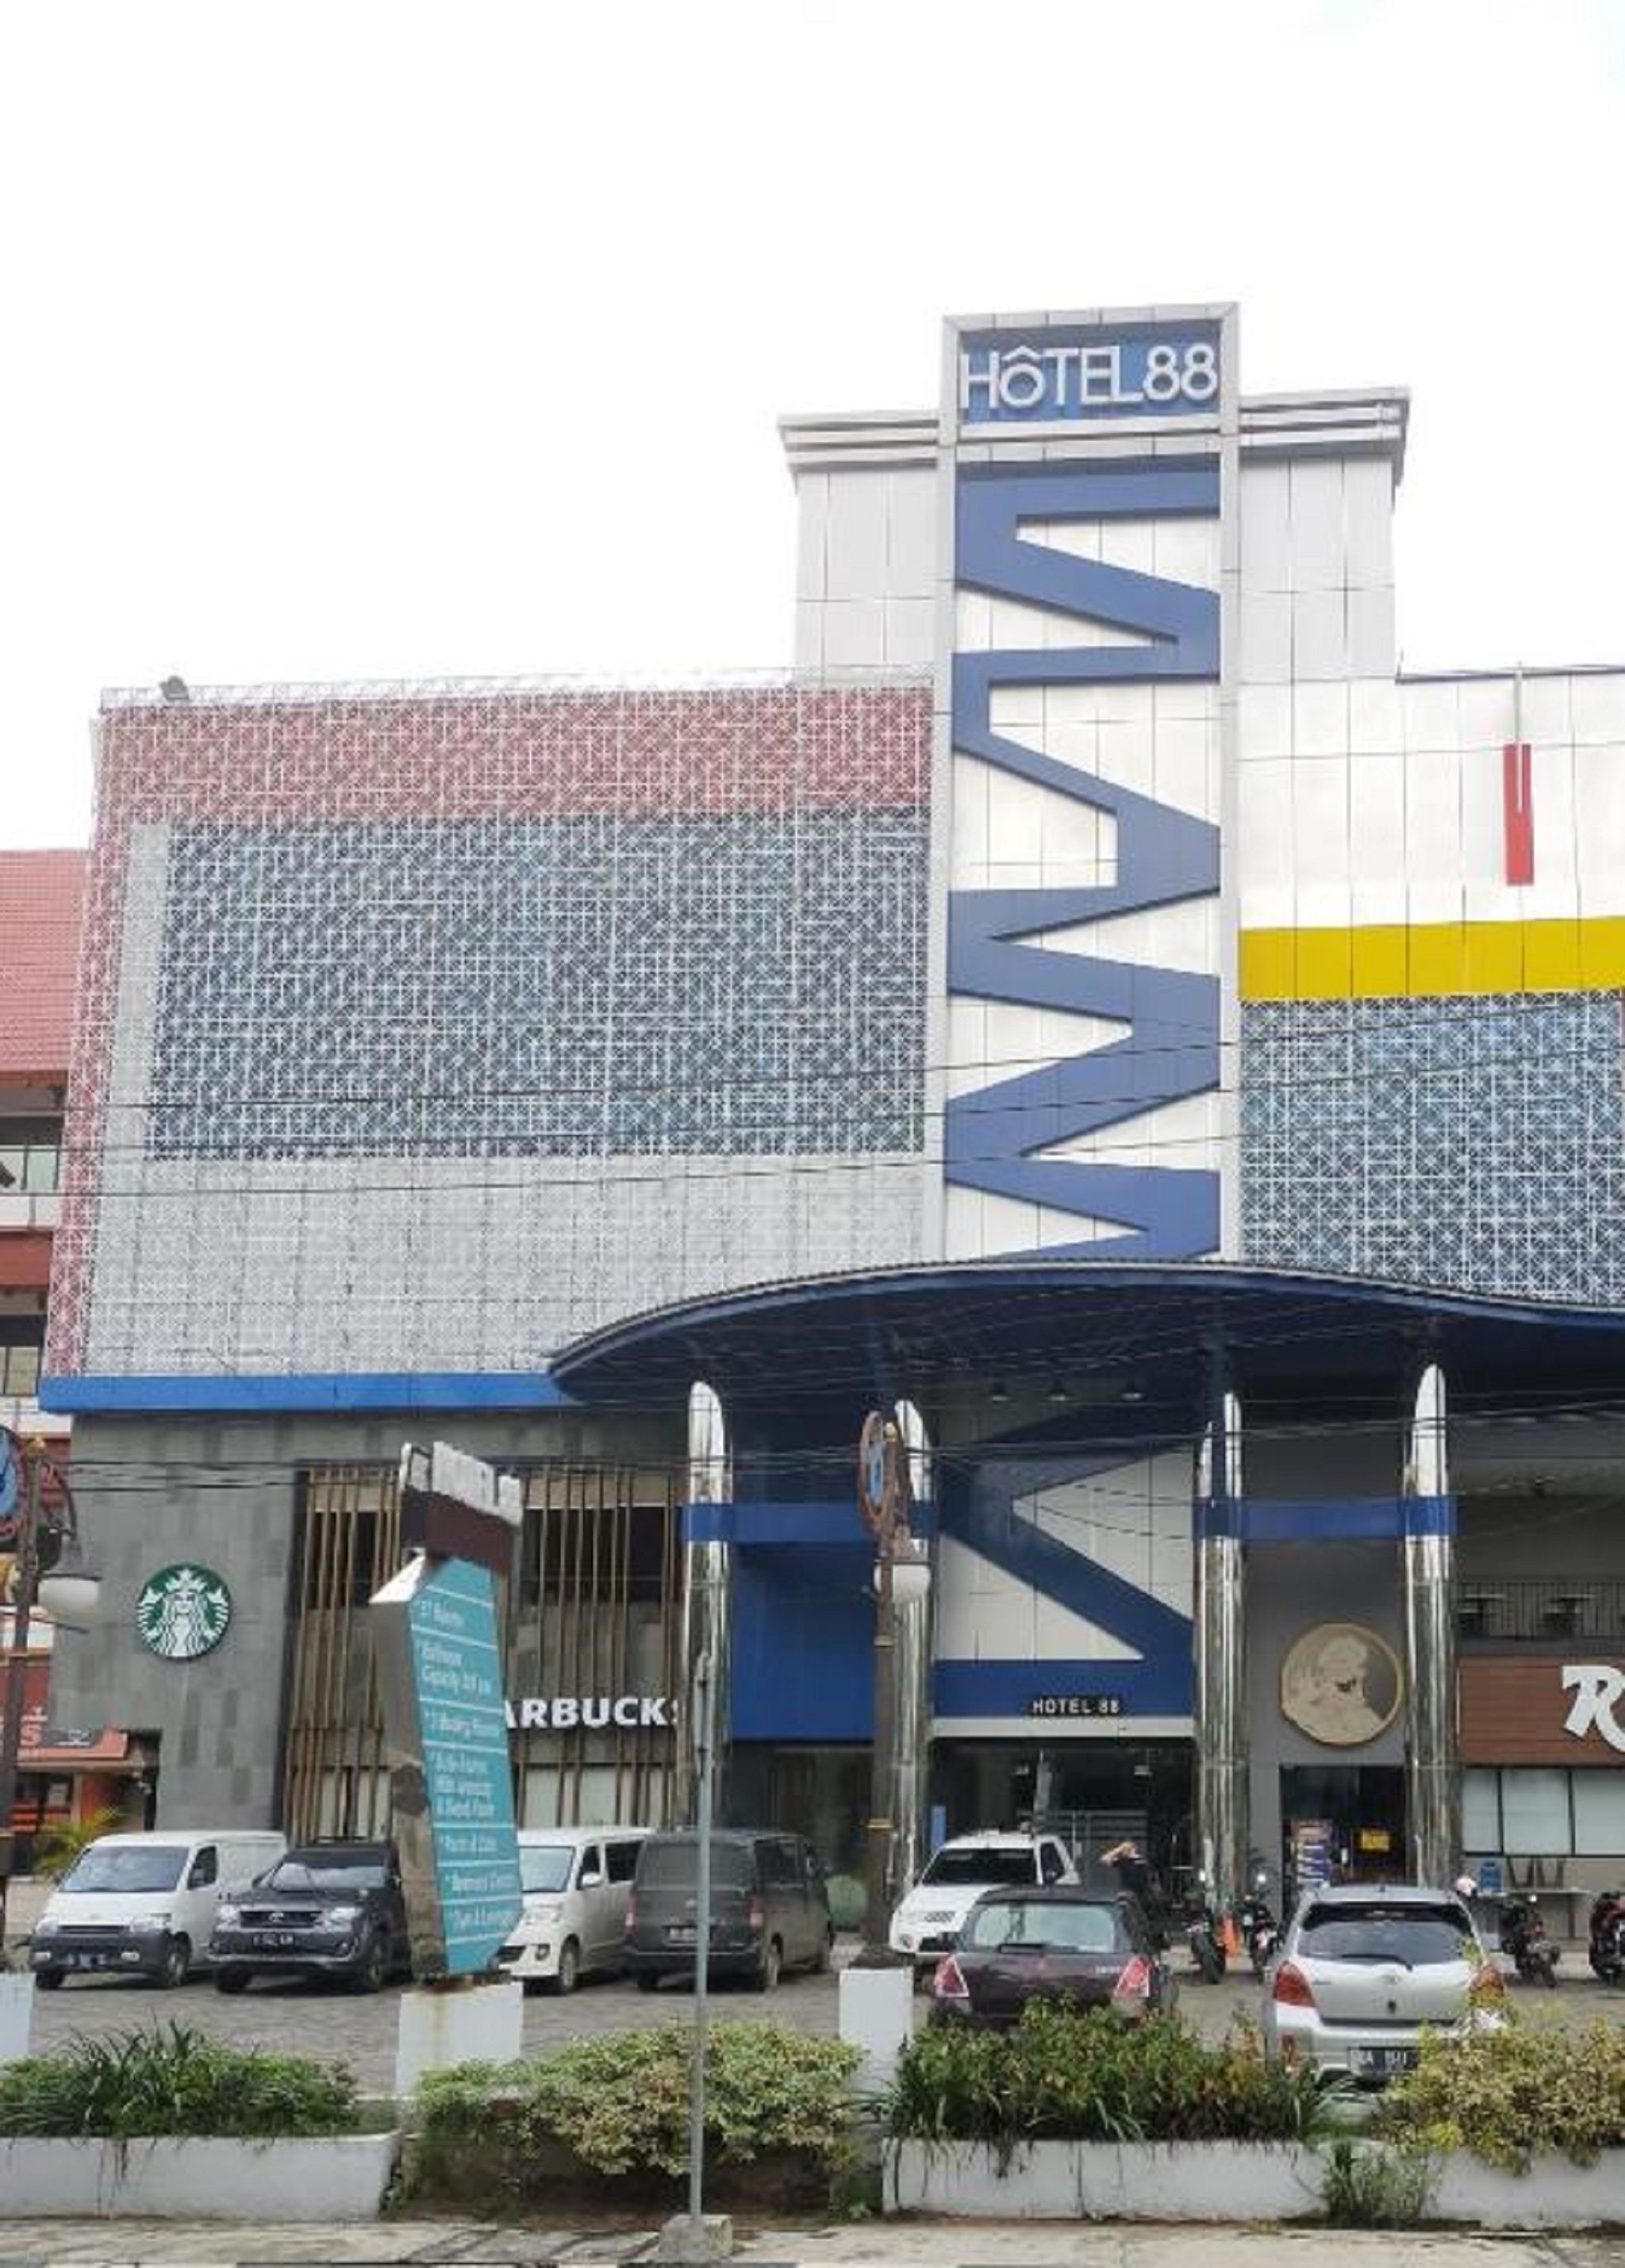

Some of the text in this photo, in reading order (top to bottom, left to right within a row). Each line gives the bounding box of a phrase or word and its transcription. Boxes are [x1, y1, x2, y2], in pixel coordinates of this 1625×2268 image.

[1143, 342, 1219, 401] 88
[1032, 1698, 1092, 1714] HOTEL
[1562, 1664, 1625, 1754] R
